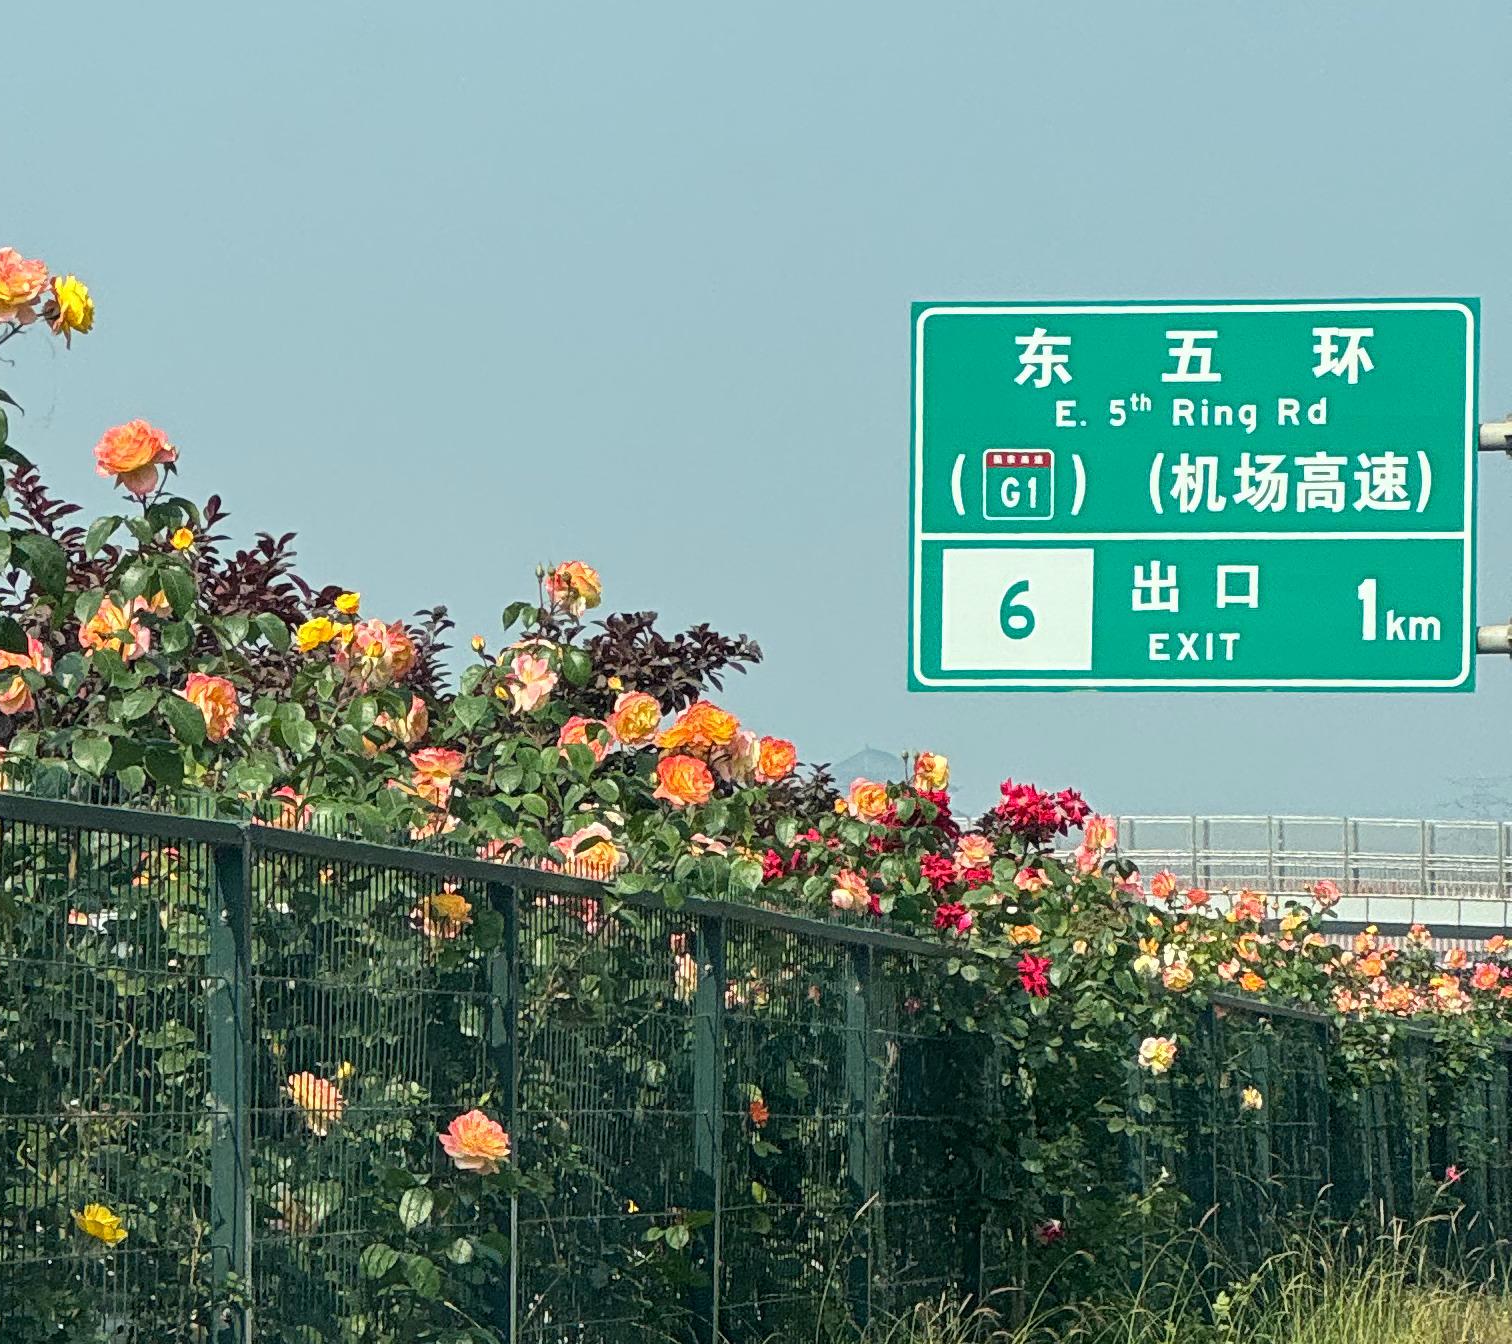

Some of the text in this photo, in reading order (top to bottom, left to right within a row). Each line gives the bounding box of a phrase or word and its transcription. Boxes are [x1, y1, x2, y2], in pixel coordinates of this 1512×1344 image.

[1014, 326, 1375, 389] 东五环
[1055, 392, 1327, 434] E. 5th Ring Rd
[1149, 450, 1432, 515] (机场高速)
[999, 579, 1036, 640] 6
[1131, 559, 1259, 613] 出口
[1148, 632, 1241, 661] EXIT
